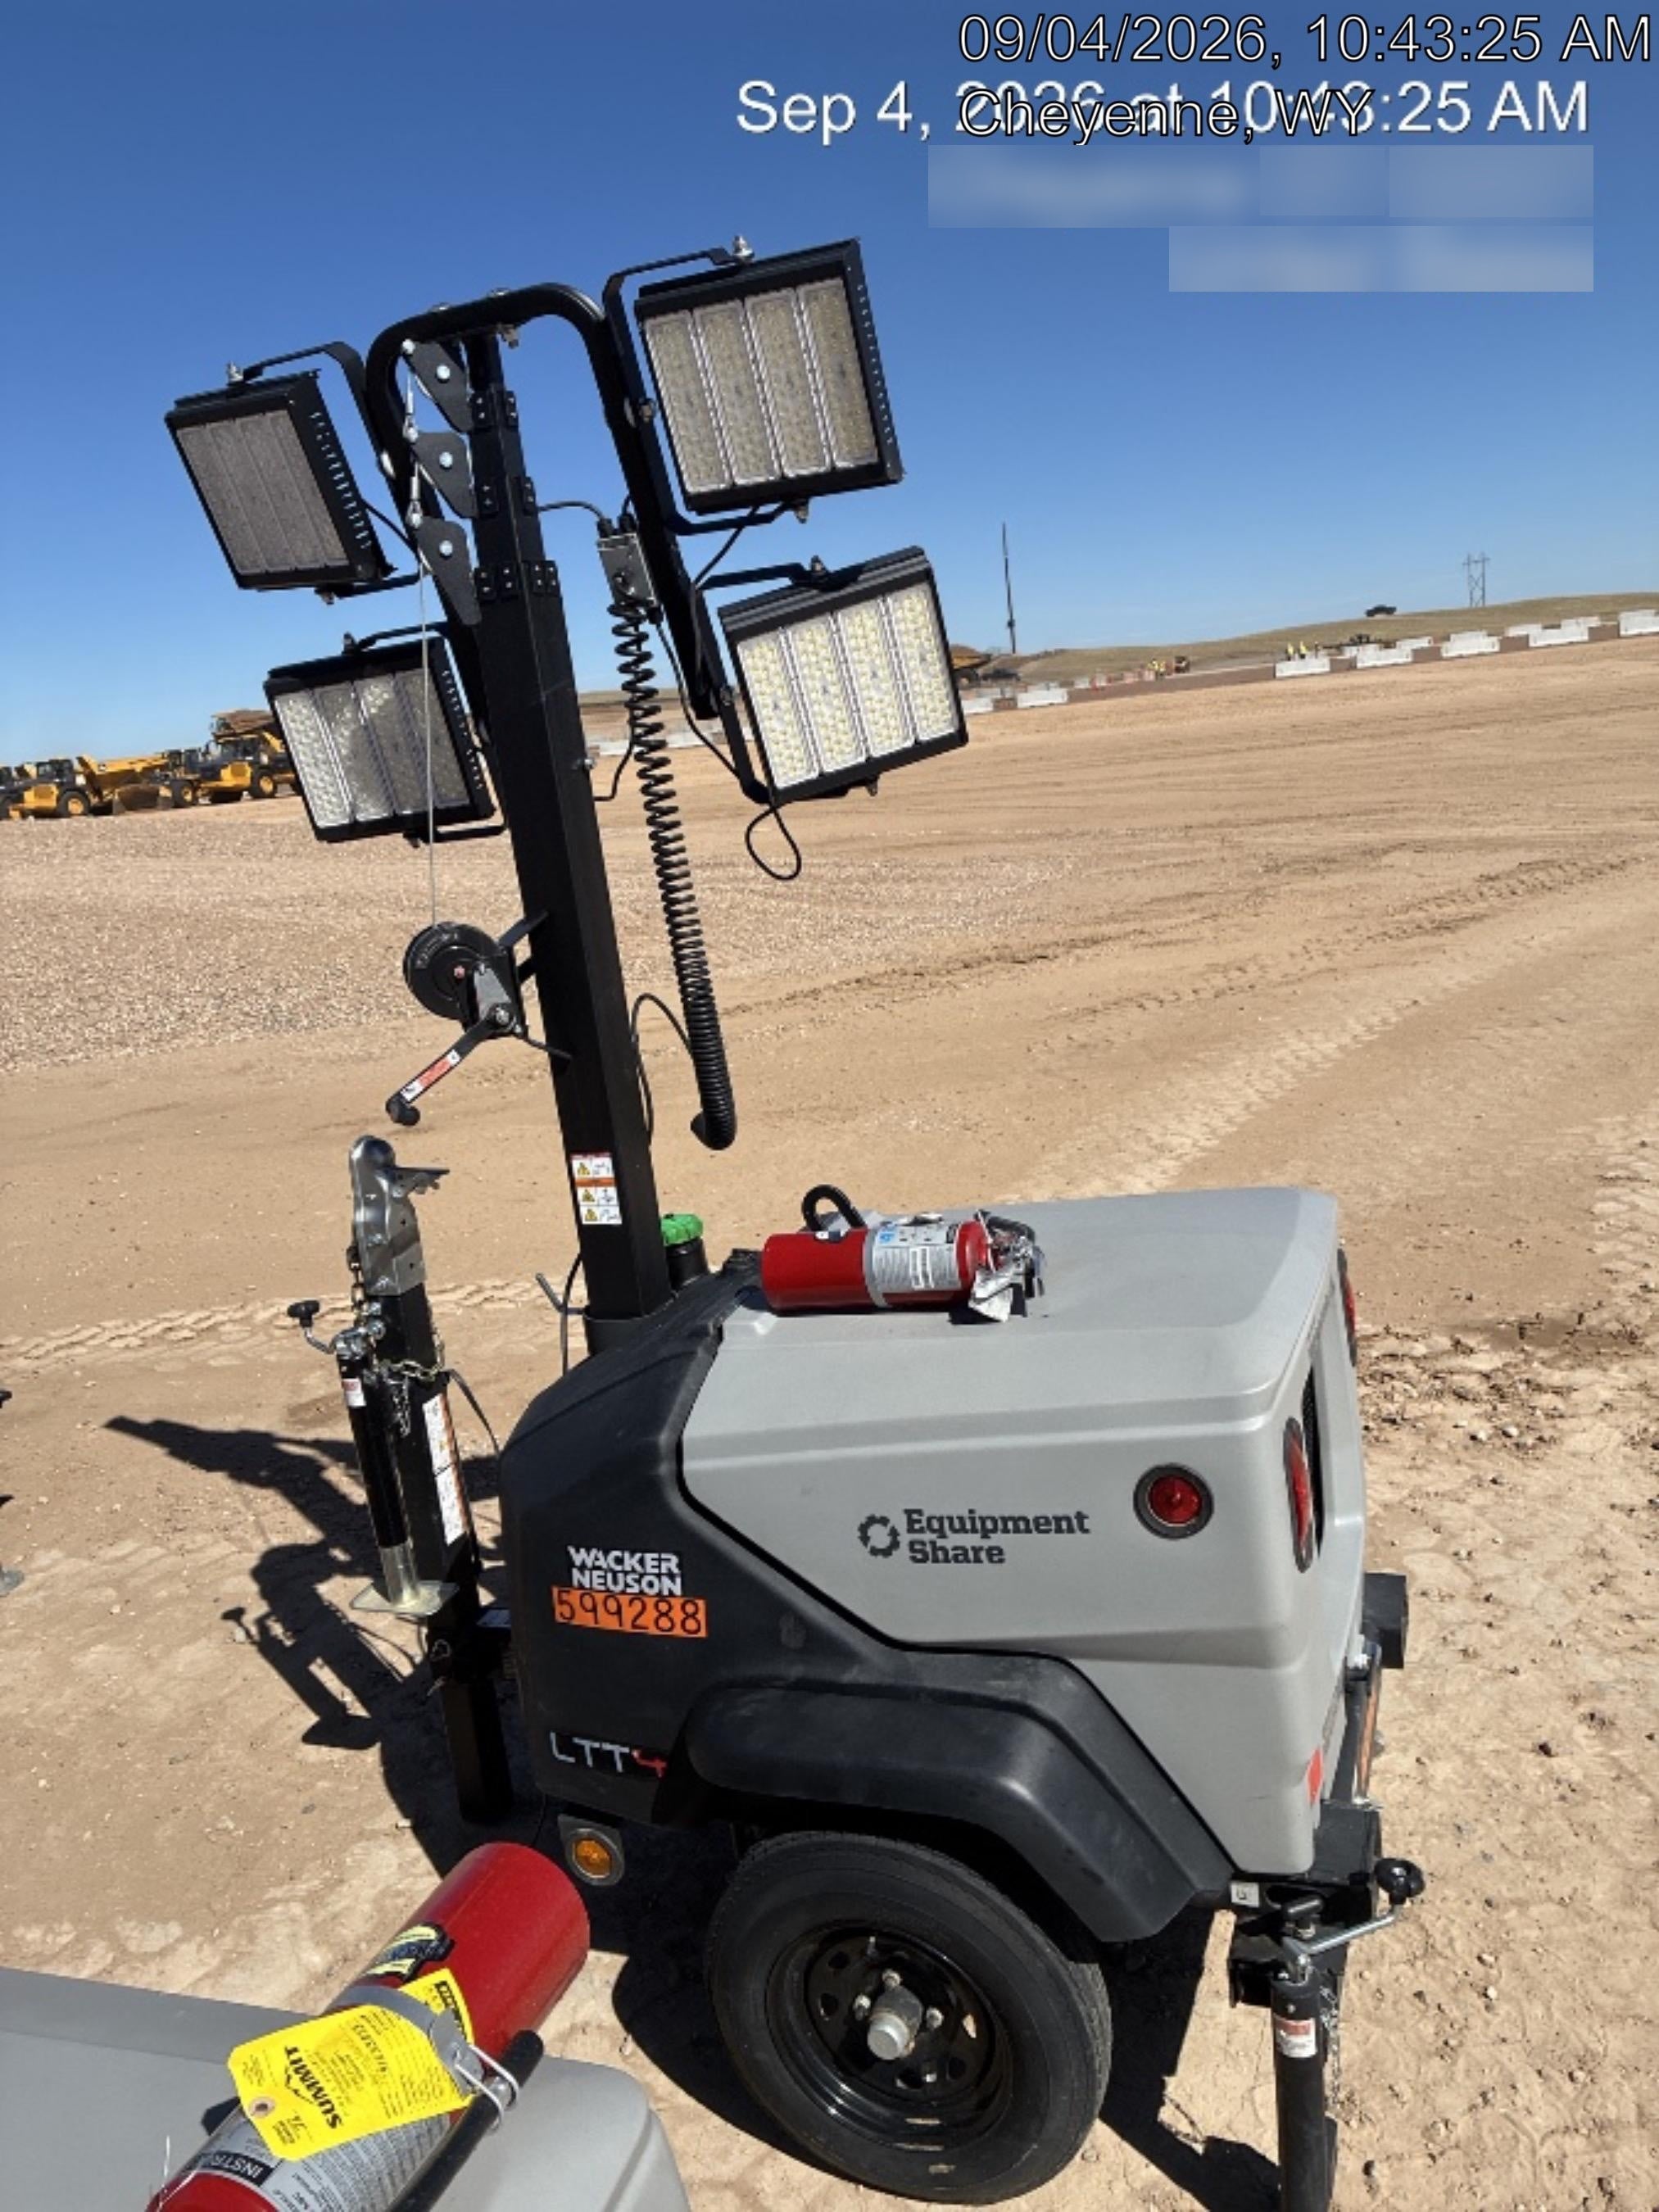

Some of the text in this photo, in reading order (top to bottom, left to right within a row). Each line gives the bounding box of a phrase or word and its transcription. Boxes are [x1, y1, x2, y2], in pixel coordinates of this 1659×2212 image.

[904, 1509, 1090, 1539] Equipment
[568, 1545, 682, 1573] WACKER
[909, 1540, 1005, 1564] Share
[572, 1568, 682, 1596] NEUSON
[556, 1589, 701, 1635] 599288
[284, 2045, 342, 2129] SUMMIT
